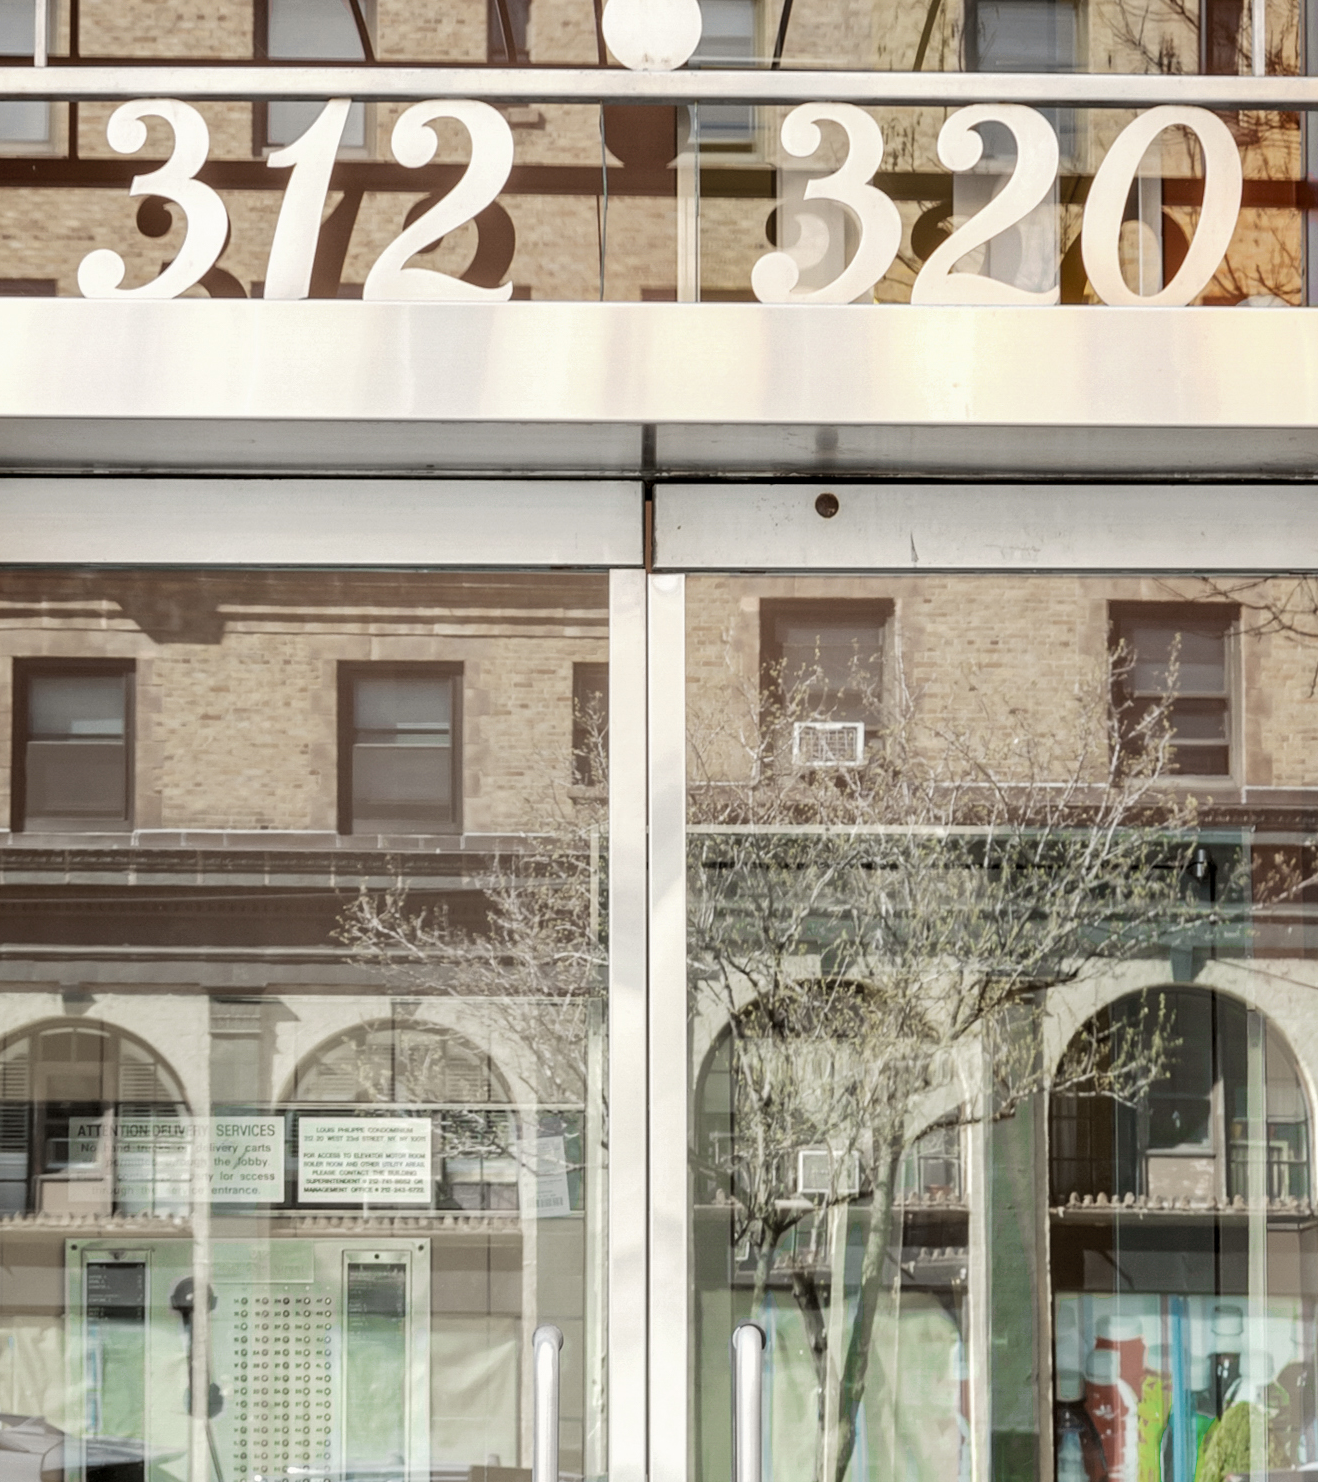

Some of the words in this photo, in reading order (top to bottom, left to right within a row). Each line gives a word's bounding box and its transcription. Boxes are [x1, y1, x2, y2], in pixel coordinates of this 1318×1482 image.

[76, 97, 516, 302] 312
[751, 101, 1244, 308] 320
[77, 1124, 150, 1138] ATTENTION
[152, 1124, 209, 1138] DELIVERY
[215, 1123, 276, 1137] SERVICES
[80, 1143, 97, 1153] No
[196, 1142, 238, 1155] delivery
[244, 1143, 272, 1153] carts
[214, 1156, 231, 1166] the
[219, 1171, 234, 1181] for
[239, 1173, 275, 1181] access
[211, 1185, 261, 1195] entrance.
